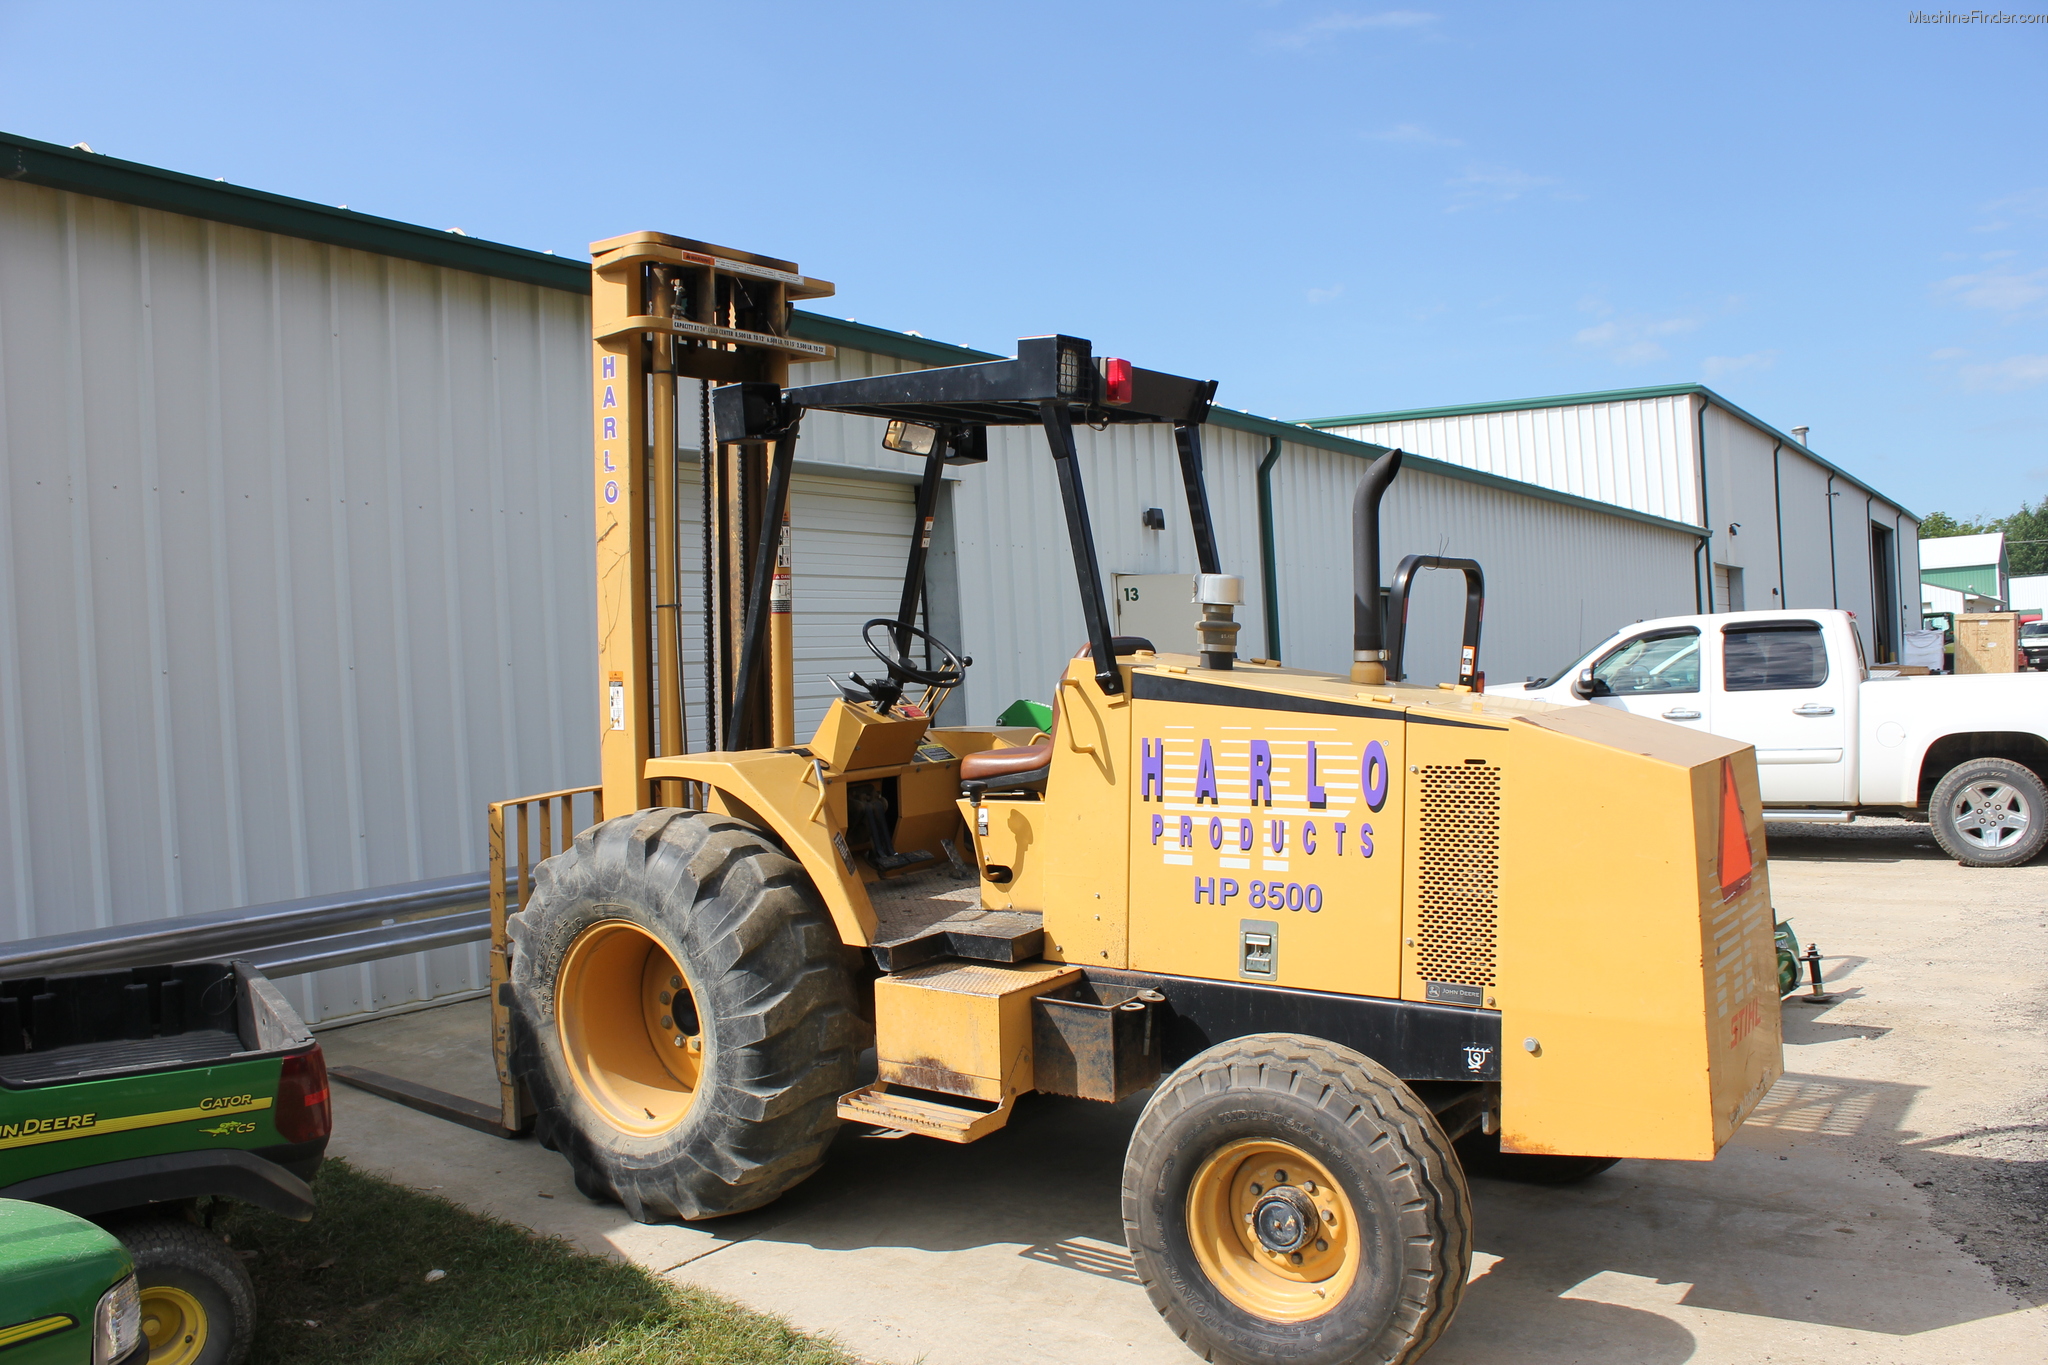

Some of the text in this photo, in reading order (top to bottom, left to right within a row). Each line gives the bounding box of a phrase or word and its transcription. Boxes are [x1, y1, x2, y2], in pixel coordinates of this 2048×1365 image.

[674, 321, 694, 331] CAPACITY
[719, 328, 734, 337] CENTER
[602, 354, 620, 504] HARLO
[1123, 587, 1139, 602] 13
[1141, 737, 1389, 813] HARLO
[1152, 813, 1374, 859] PRODUCTS
[1194, 876, 1323, 913] HP 8500
[1442, 988, 1480, 998] JOHN DEERE
[1731, 996, 1762, 1050] STIHL
[200, 1094, 252, 1110] GATOR
[0, 1112, 96, 1138] N DEERE
[236, 1122, 256, 1133] CS
[1218, 1109, 1326, 1148] INDUSTRIAL
